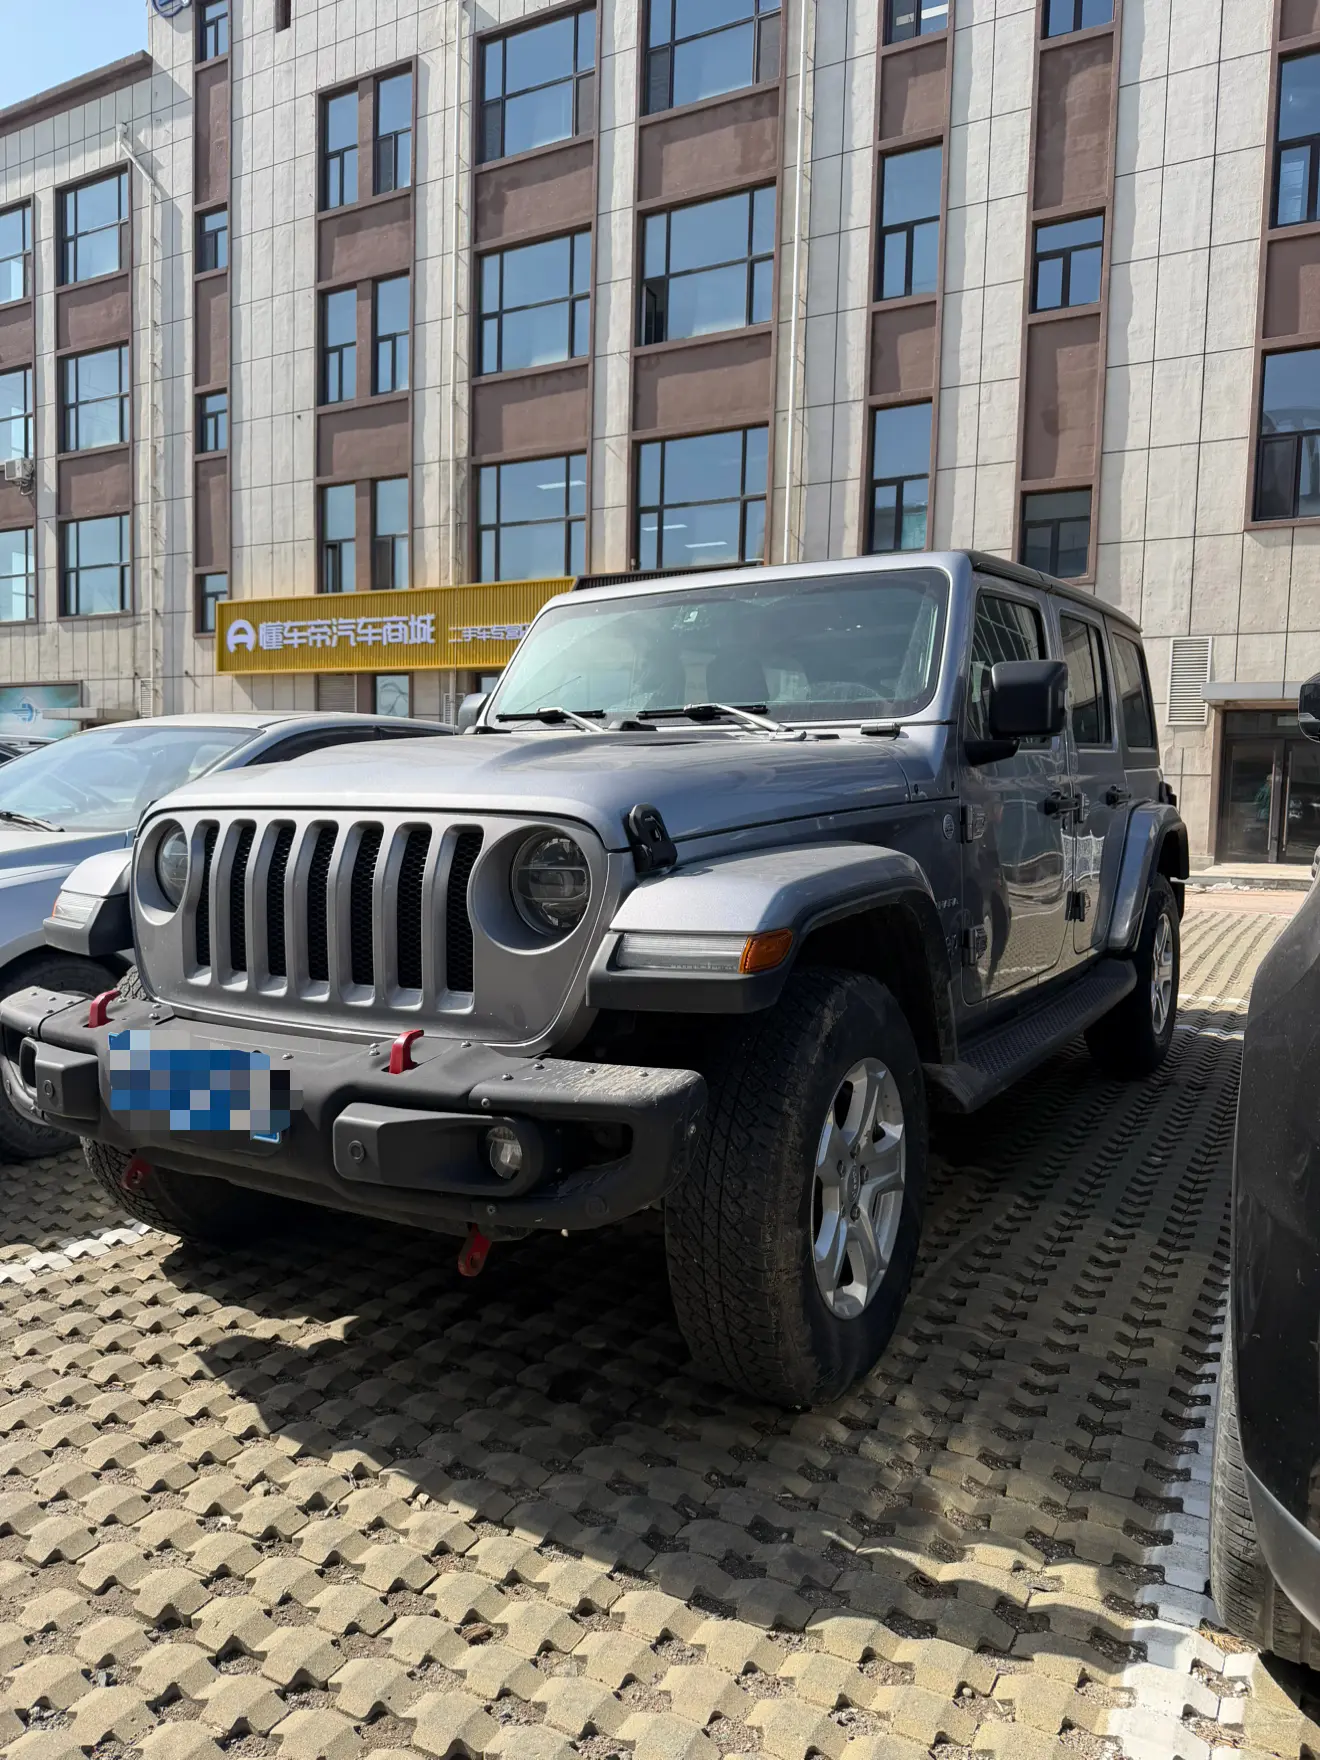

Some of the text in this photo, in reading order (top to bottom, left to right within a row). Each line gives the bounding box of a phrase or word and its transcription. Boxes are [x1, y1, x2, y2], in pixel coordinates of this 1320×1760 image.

[258, 613, 436, 650] 懂车帝汽车商城
